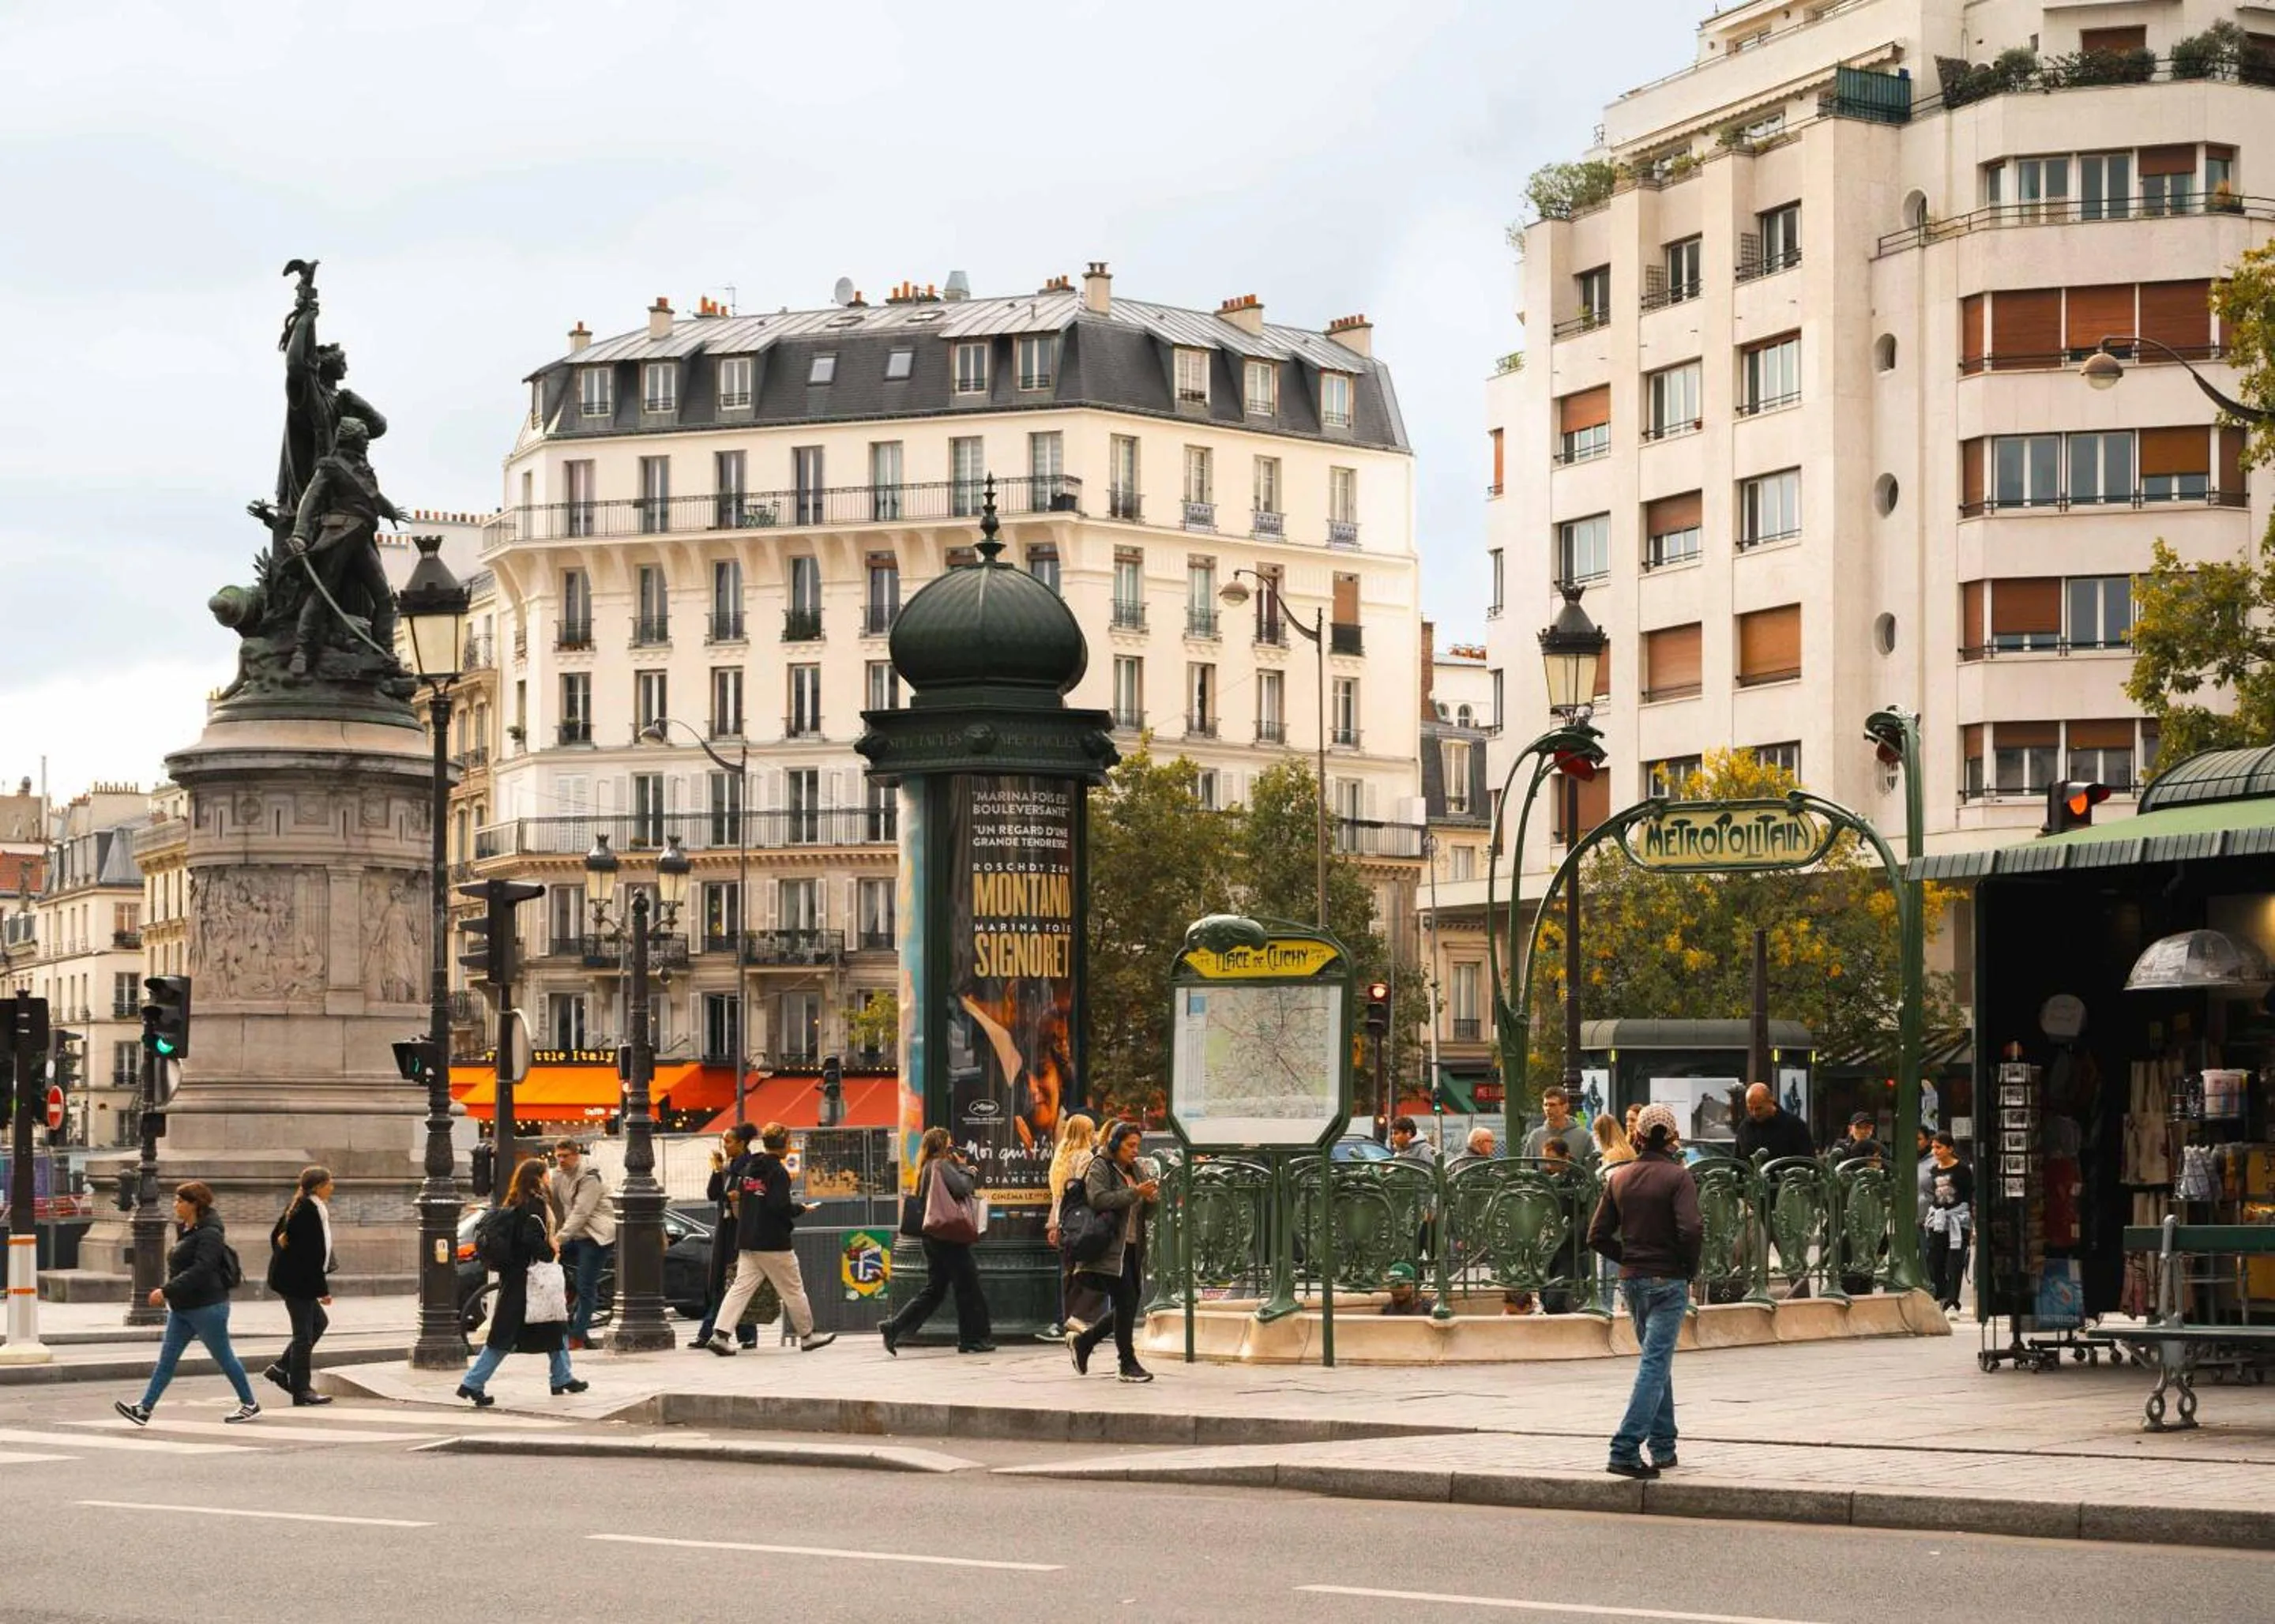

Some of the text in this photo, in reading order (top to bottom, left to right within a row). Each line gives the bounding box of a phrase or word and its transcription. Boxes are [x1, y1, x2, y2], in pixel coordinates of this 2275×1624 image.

[999, 825, 1043, 835] REGARD
[972, 838, 1020, 847] GRANDE
[973, 873, 1070, 918] MONTAND
[975, 923, 1038, 932] MARINA
[974, 933, 1070, 978] SIGNORET
[534, 1050, 615, 1063] ttle Italy
[985, 1175, 1028, 1184] DIANE
